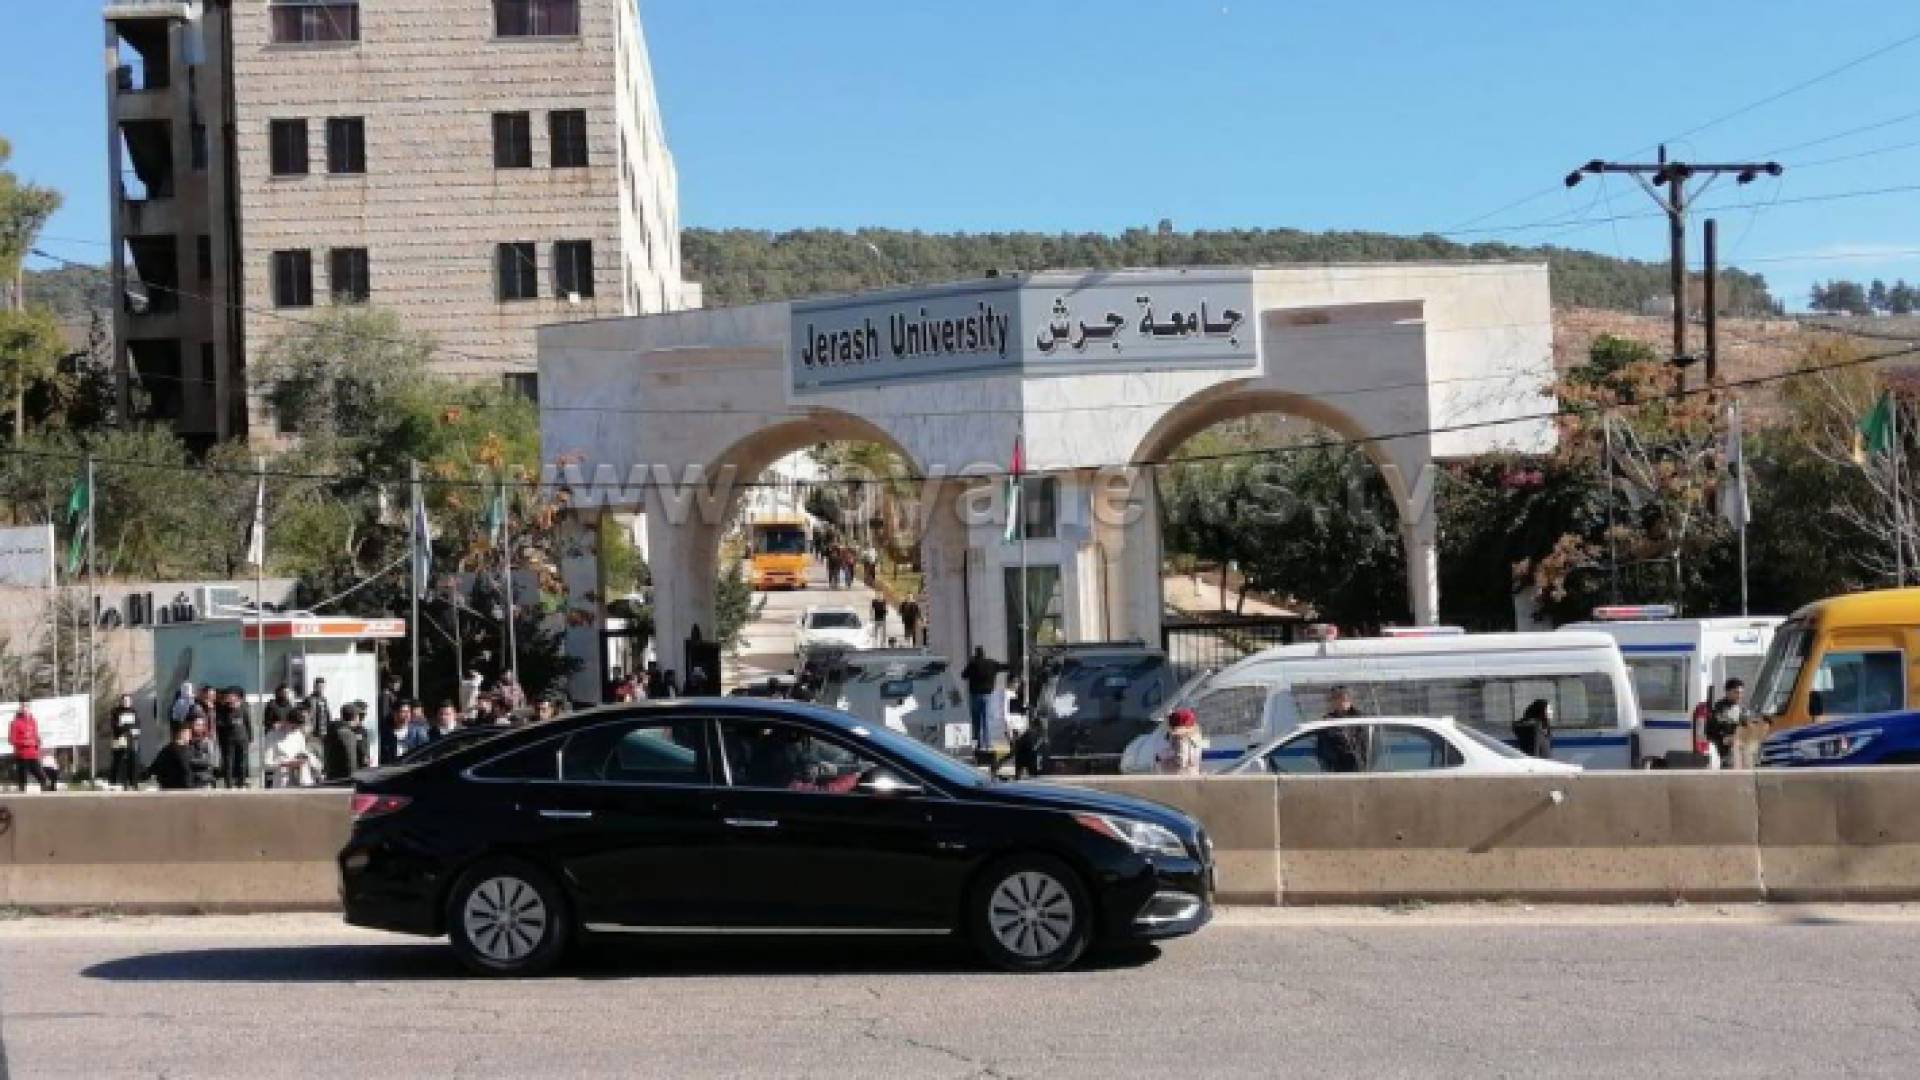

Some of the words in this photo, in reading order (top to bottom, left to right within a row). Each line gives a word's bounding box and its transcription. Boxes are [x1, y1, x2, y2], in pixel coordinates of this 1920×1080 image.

[802, 323, 879, 369] Jerash
[890, 302, 1008, 358] University
[1037, 297, 1124, 352] جرش
[1137, 296, 1243, 346] جامعة
